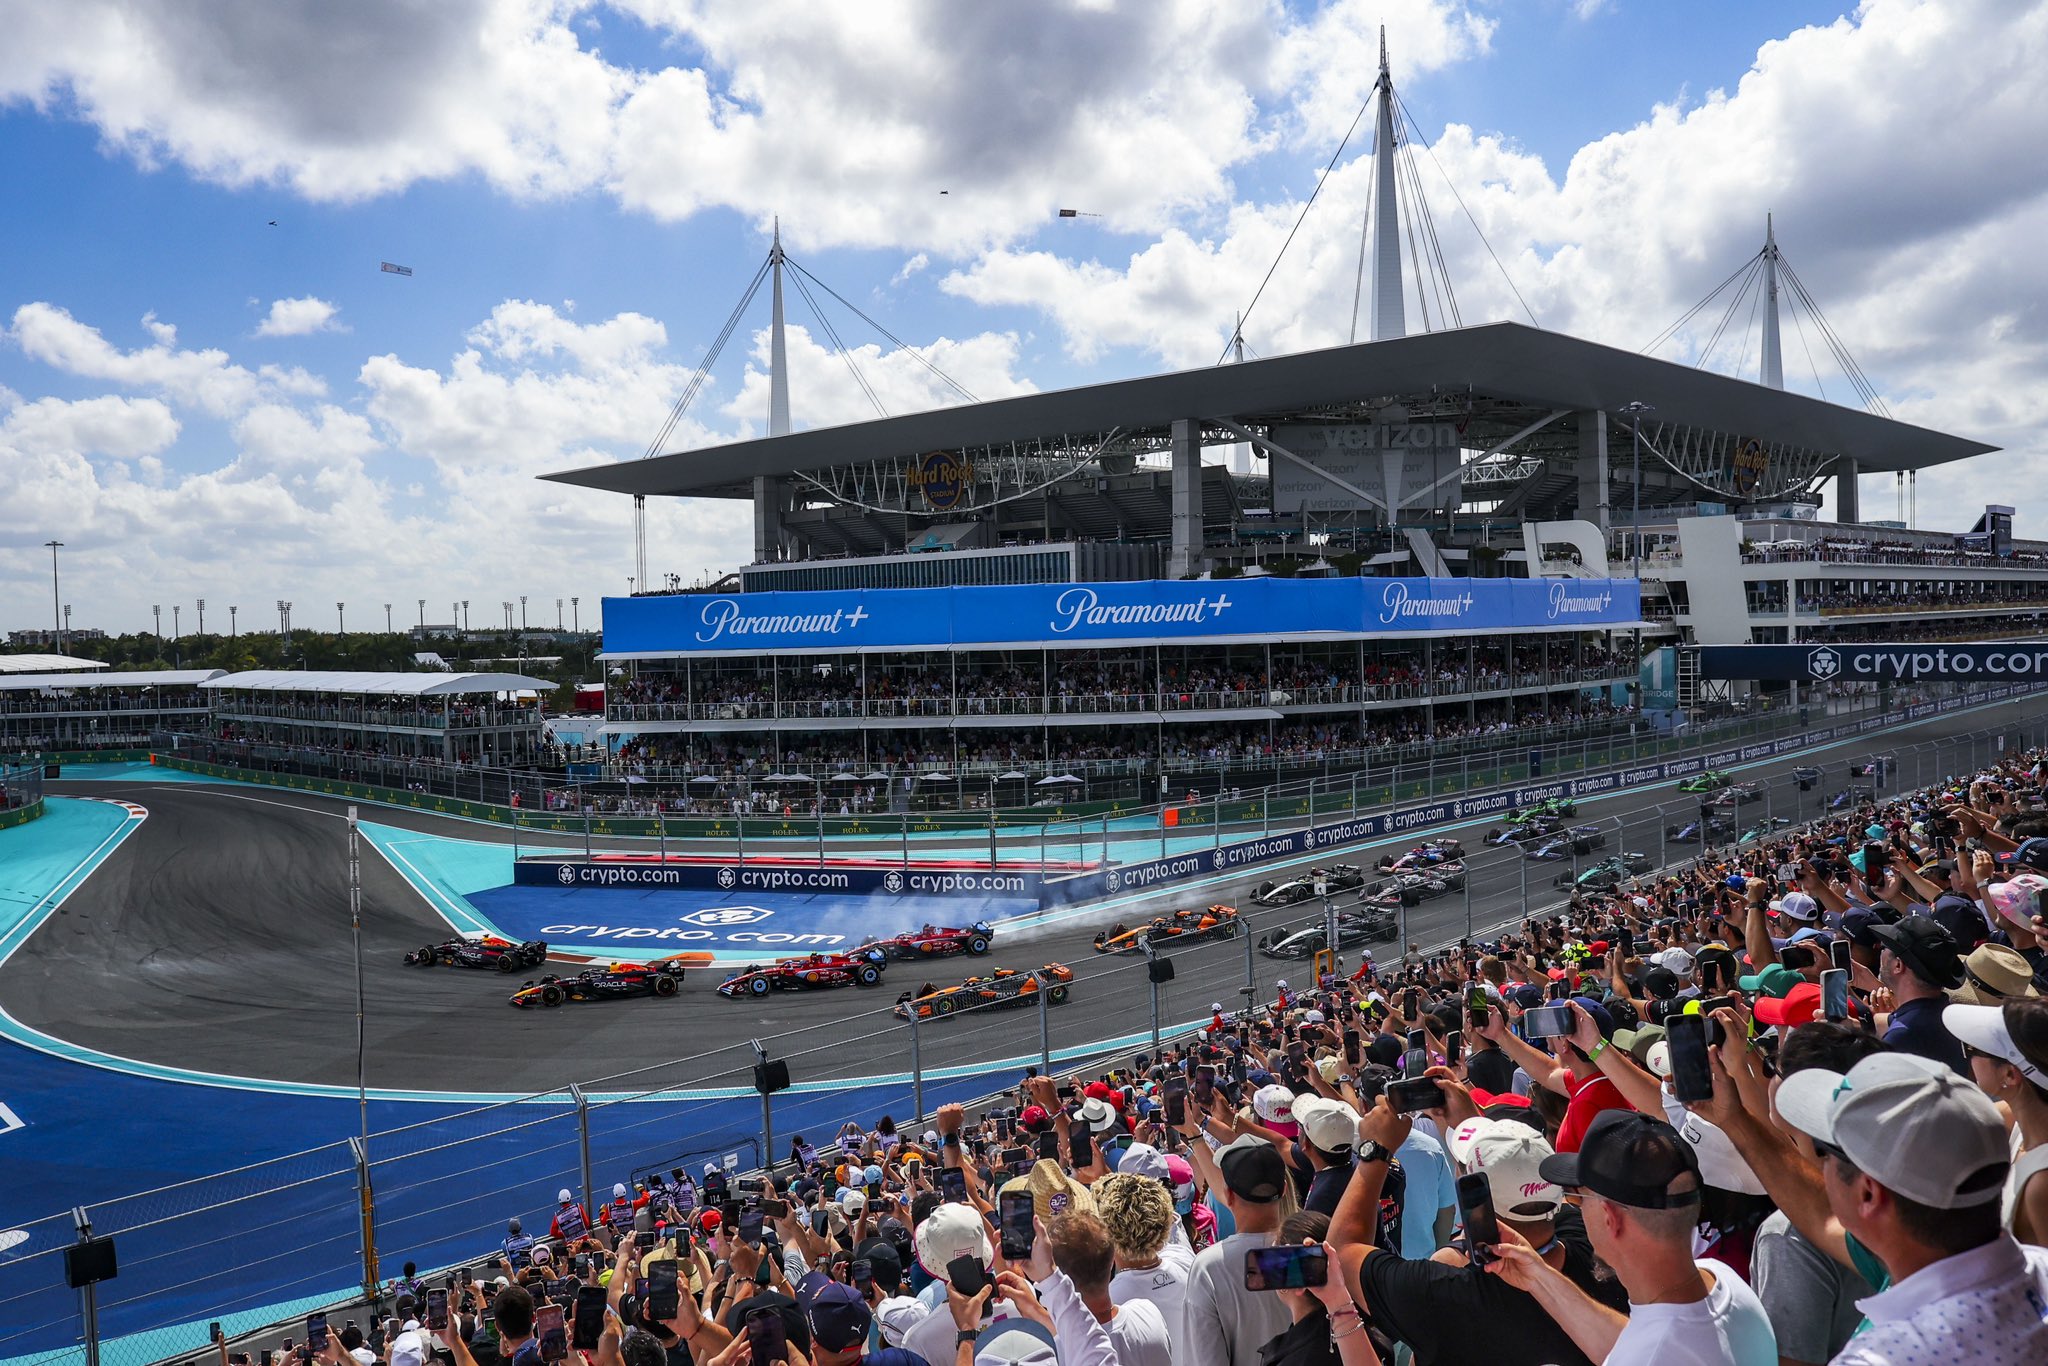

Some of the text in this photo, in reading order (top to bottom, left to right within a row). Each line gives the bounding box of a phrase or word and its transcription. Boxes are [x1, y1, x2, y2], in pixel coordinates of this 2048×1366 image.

[907, 462, 975, 486] Hard Rock
[1050, 588, 1232, 633] Paramount+
[1380, 582, 1473, 623] Paramount+
[1547, 583, 1611, 619] Paramount+
[695, 599, 869, 643] Paramount+
[1709, 752, 1737, 767] crypto.com
[1745, 745, 1770, 760] crypto.com
[1626, 768, 1659, 784] crypto.com
[1670, 760, 1699, 775] crypto.com
[1578, 775, 1614, 792] crypto.com
[1524, 785, 1563, 802] crypto.com
[1464, 795, 1508, 814] crypto.com
[1242, 812, 1264, 820] ROLEX
[1395, 807, 1445, 828] crypto.com
[551, 823, 567, 831] ROLEX
[1317, 820, 1374, 845] crypto.com
[1228, 837, 1293, 863] crypto.com
[581, 866, 679, 884] crypto.com
[742, 869, 848, 888] crypto.com
[1124, 857, 1198, 885] crypto.com
[910, 873, 1024, 892] crypto.com
[540, 924, 846, 945] crypto.com
[1519, 1182, 1553, 1198] Miam
[1382, 1205, 1400, 1221] Bull
